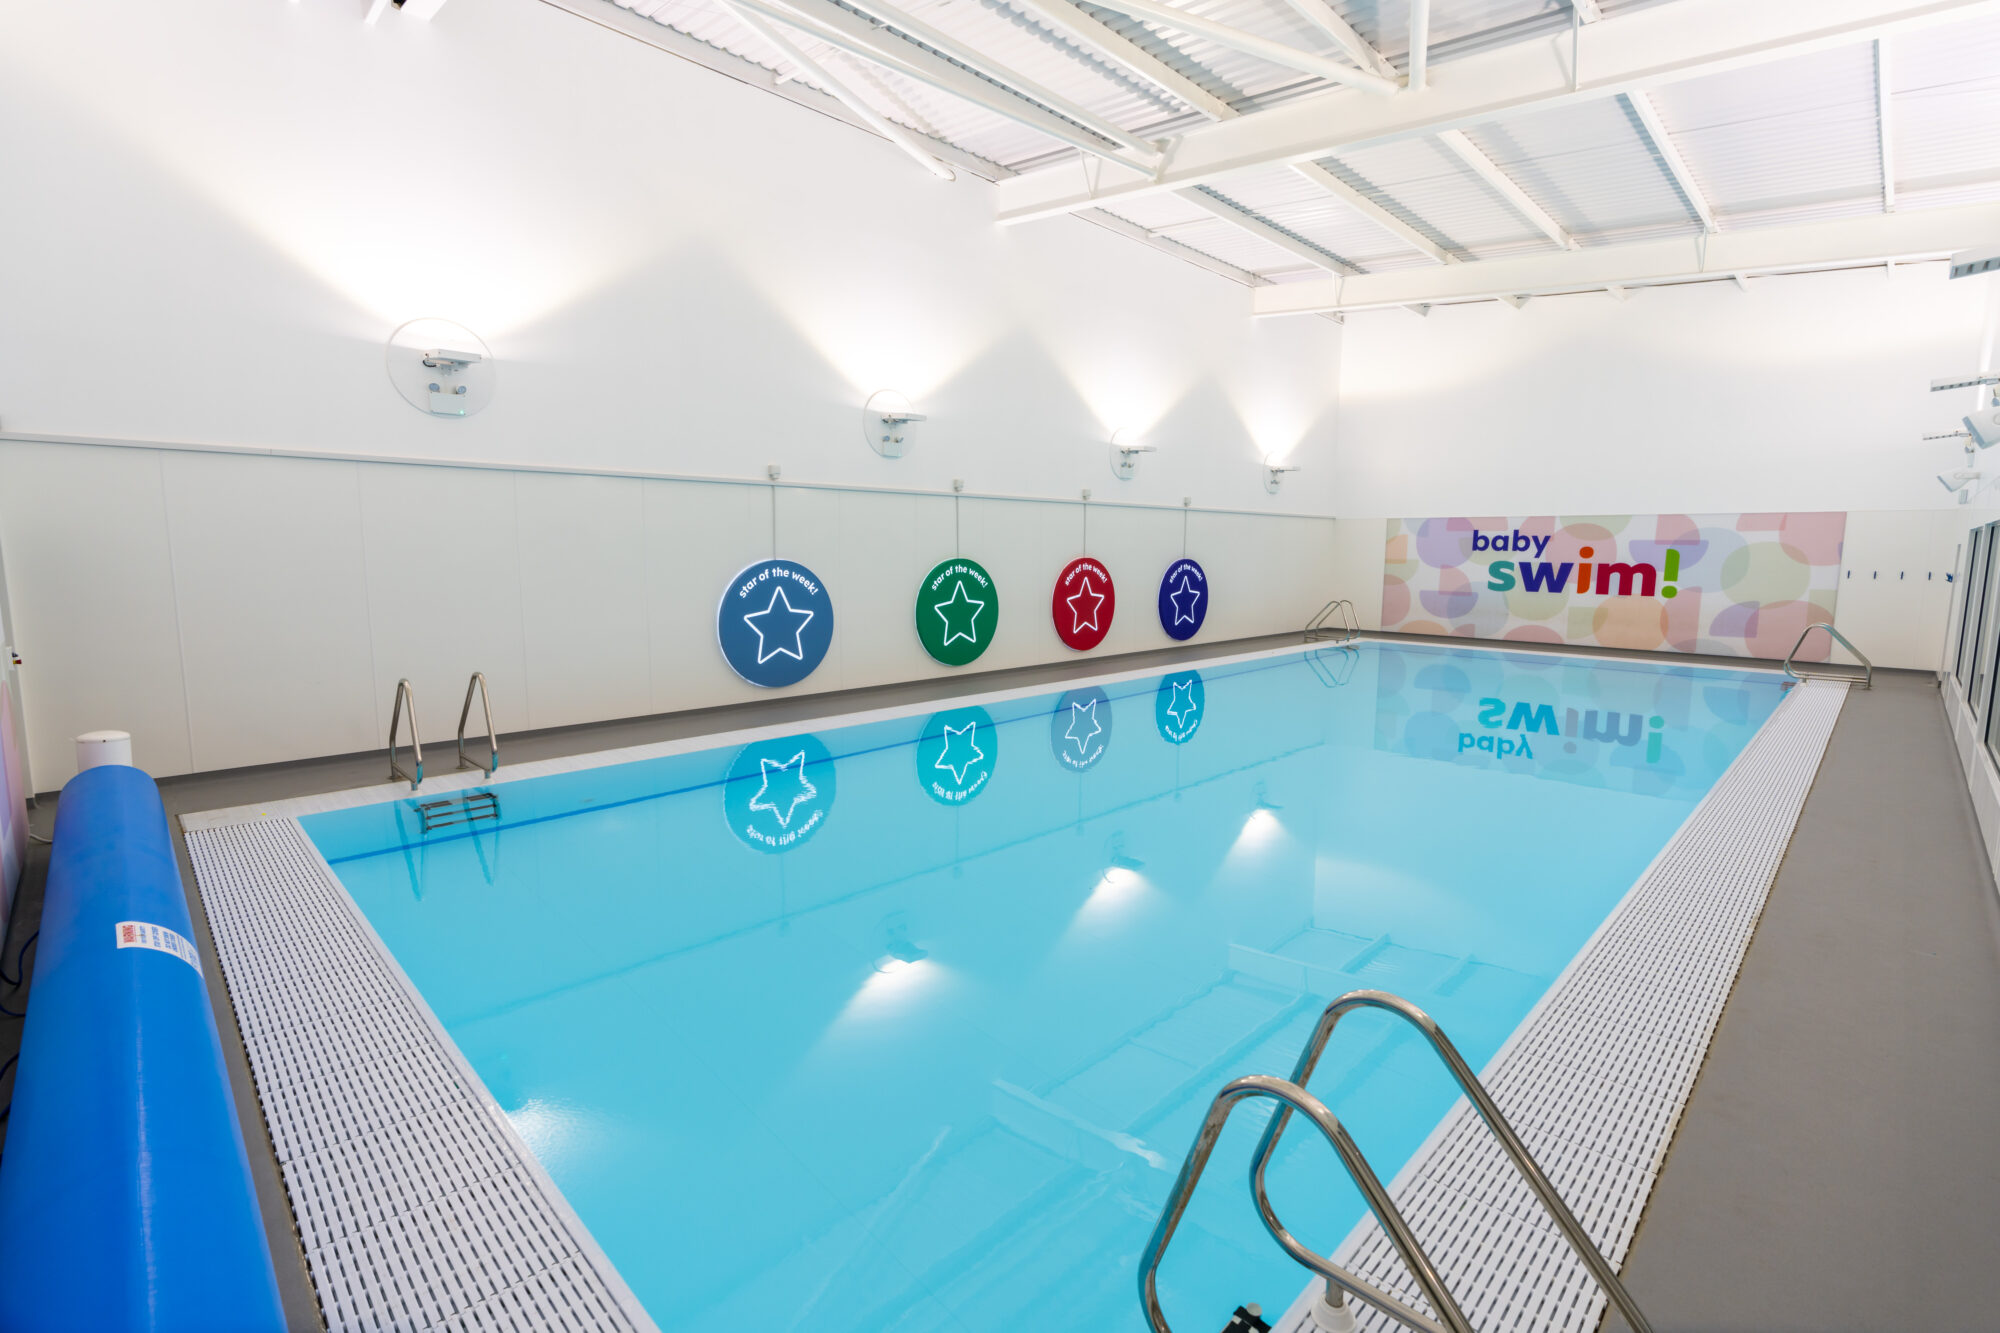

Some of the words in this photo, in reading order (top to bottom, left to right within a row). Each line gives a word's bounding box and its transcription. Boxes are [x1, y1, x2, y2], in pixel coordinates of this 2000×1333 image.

[1472, 530, 1551, 558] baby
[931, 573, 945, 591] star
[945, 566, 953, 577] of
[955, 564, 967, 573] the
[969, 568, 988, 588] week!
[1082, 562, 1092, 571] the
[1487, 546, 1681, 599] swim!
[739, 577, 757, 598] star
[758, 569, 769, 581] of
[772, 567, 789, 577] the
[792, 571, 819, 595] week!
